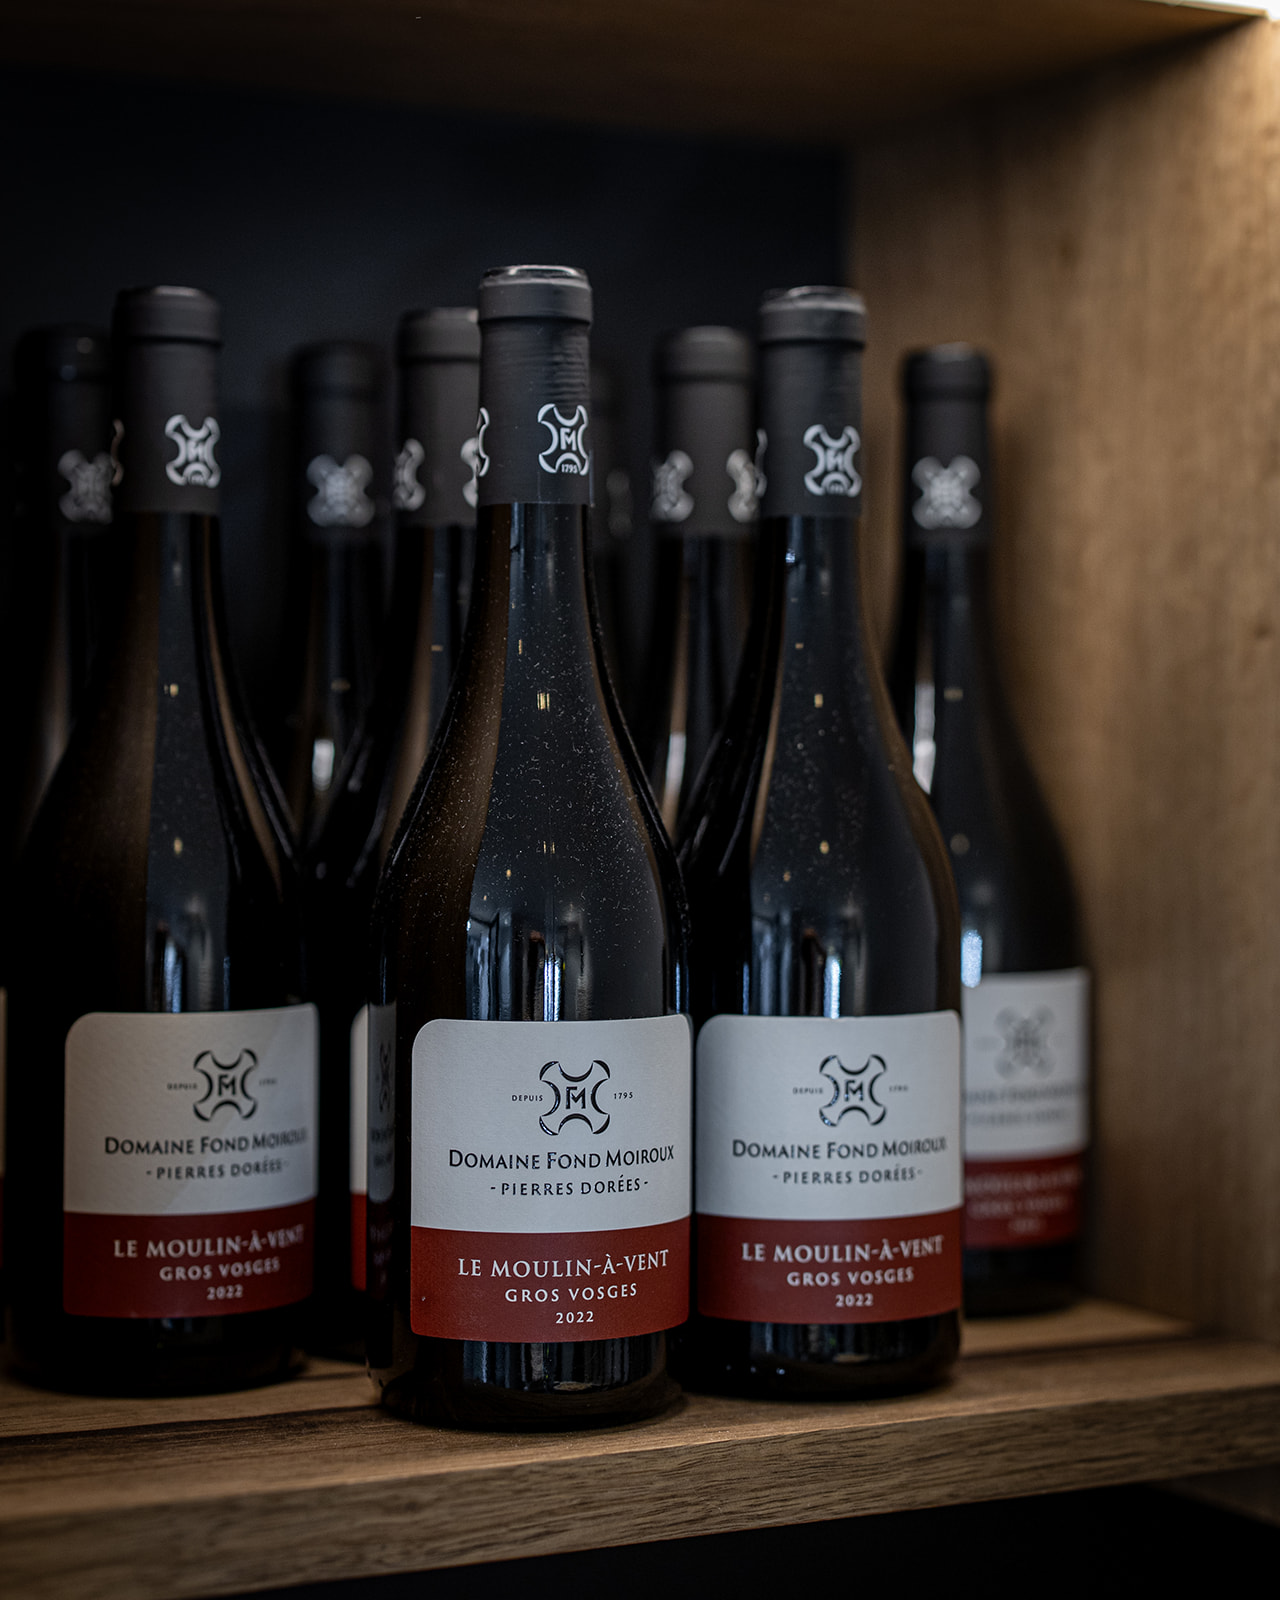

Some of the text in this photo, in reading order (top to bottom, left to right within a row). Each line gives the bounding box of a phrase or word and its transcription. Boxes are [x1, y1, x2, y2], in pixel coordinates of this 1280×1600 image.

[105, 1137, 193, 1155] DOMAINE
[200, 1137, 247, 1153] FOND
[733, 1137, 946, 1159] DOMAINE FOND MOIROUX
[449, 1145, 674, 1169] DOMAINE FOND MOIROUX
[114, 1224, 304, 1258] LE MOULIN-À-VENT
[742, 1235, 944, 1263] LE MOULIN-À-VENT
[160, 1257, 279, 1281] GROS VOSGES
[458, 1249, 669, 1278] LE MOULIN-À-VENT
[787, 1267, 913, 1287] GROS VOSGES
[207, 1284, 243, 1300] 2022
[505, 1283, 637, 1302] GROS VOSGES
[836, 1293, 873, 1307] 2022
[556, 1311, 594, 1324] 2022
